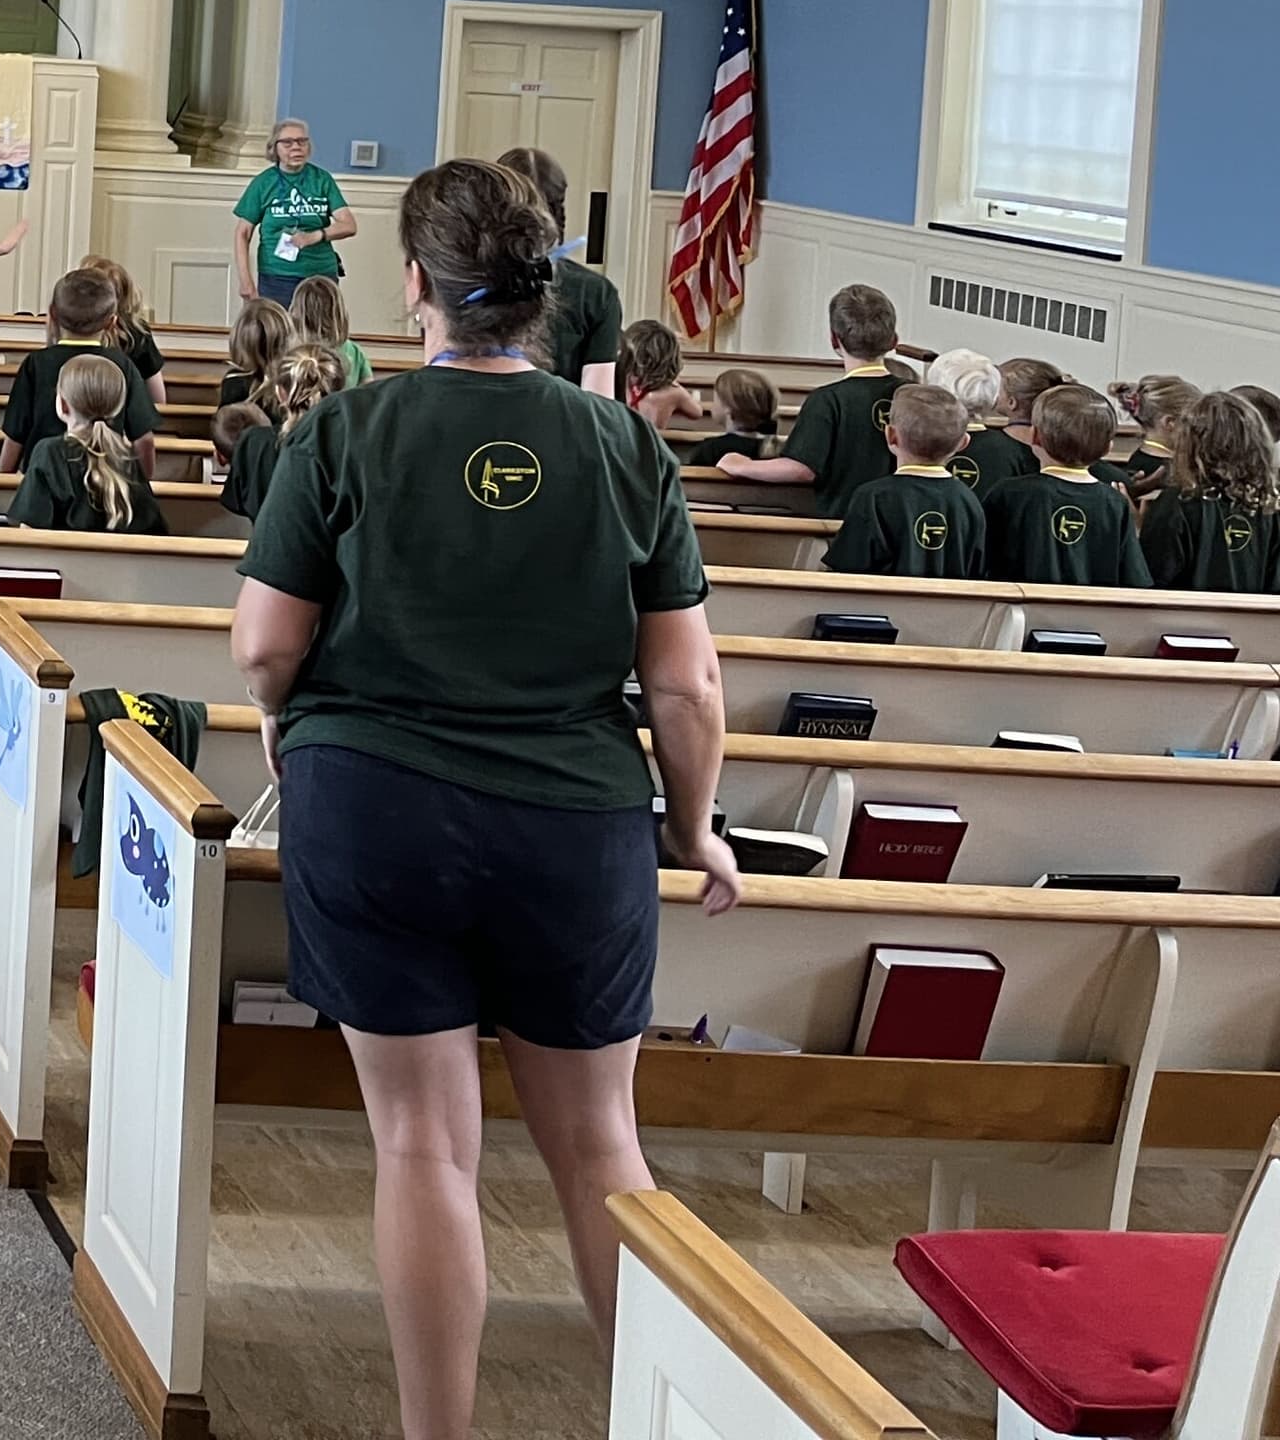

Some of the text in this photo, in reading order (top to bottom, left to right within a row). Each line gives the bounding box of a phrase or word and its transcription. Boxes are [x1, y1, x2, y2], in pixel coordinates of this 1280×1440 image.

[48, 692, 56, 703] 9
[798, 721, 869, 736] HYMNAL
[200, 844, 218, 858] 10
